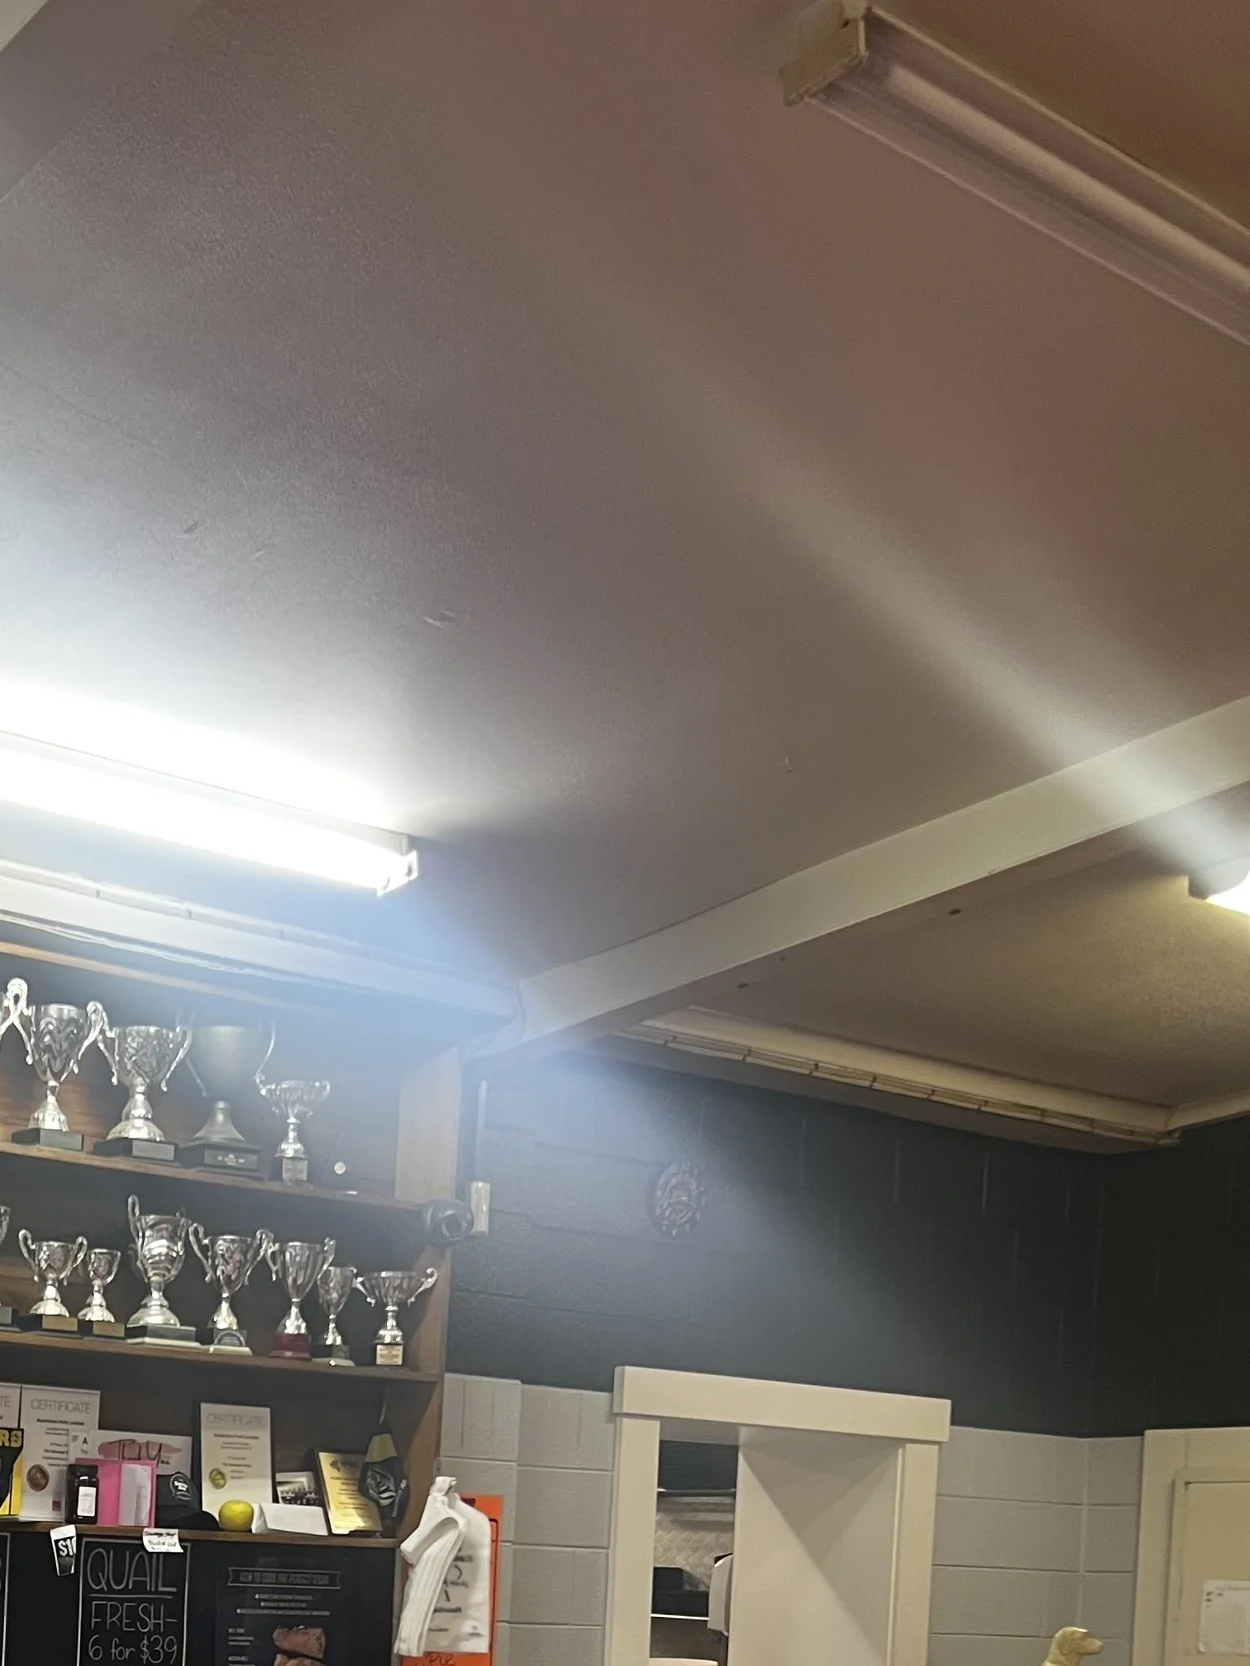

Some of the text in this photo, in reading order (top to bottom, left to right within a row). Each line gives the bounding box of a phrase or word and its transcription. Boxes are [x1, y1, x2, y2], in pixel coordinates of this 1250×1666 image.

[30, 1397, 91, 1414] CERTIFICATE
[87, 1548, 178, 1592] QUAIL
[88, 1634, 178, 1664] 6 for $39
